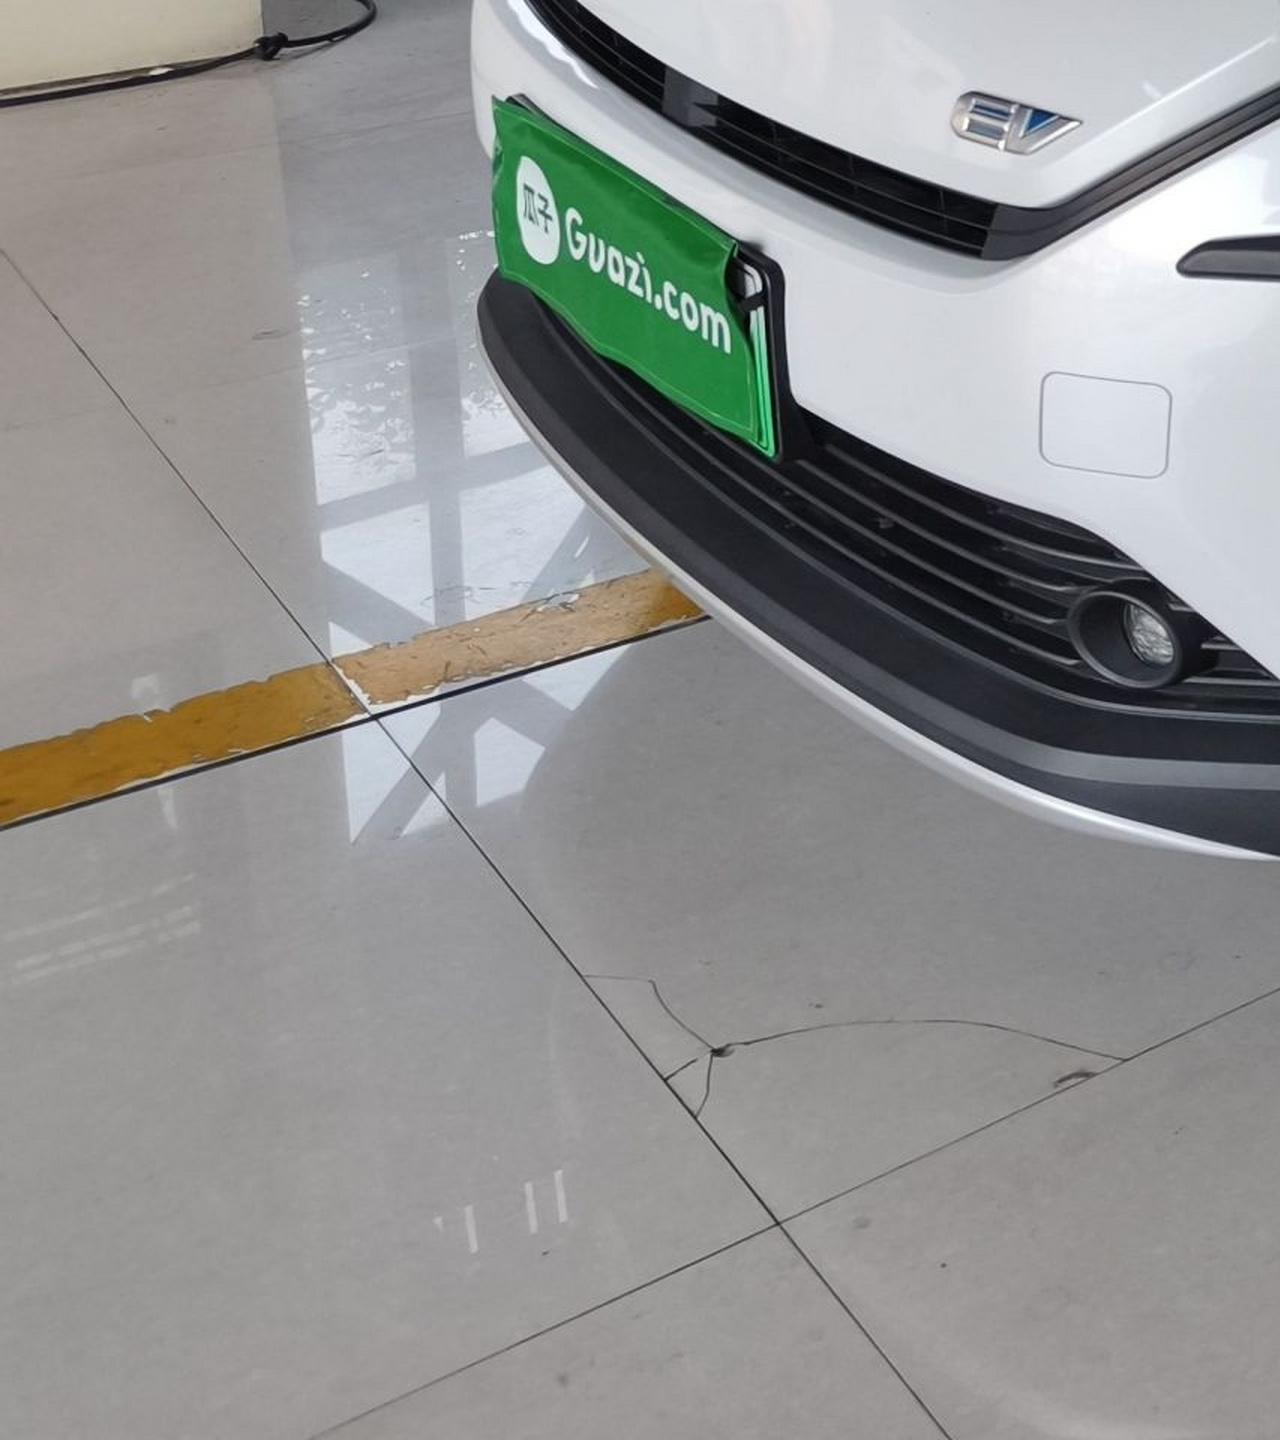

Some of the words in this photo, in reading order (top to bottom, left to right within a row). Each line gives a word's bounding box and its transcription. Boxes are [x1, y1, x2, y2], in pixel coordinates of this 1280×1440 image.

[951, 91, 1083, 155] EV
[522, 183, 554, 234] 瓜子
[565, 207, 731, 354] Guazi.com
